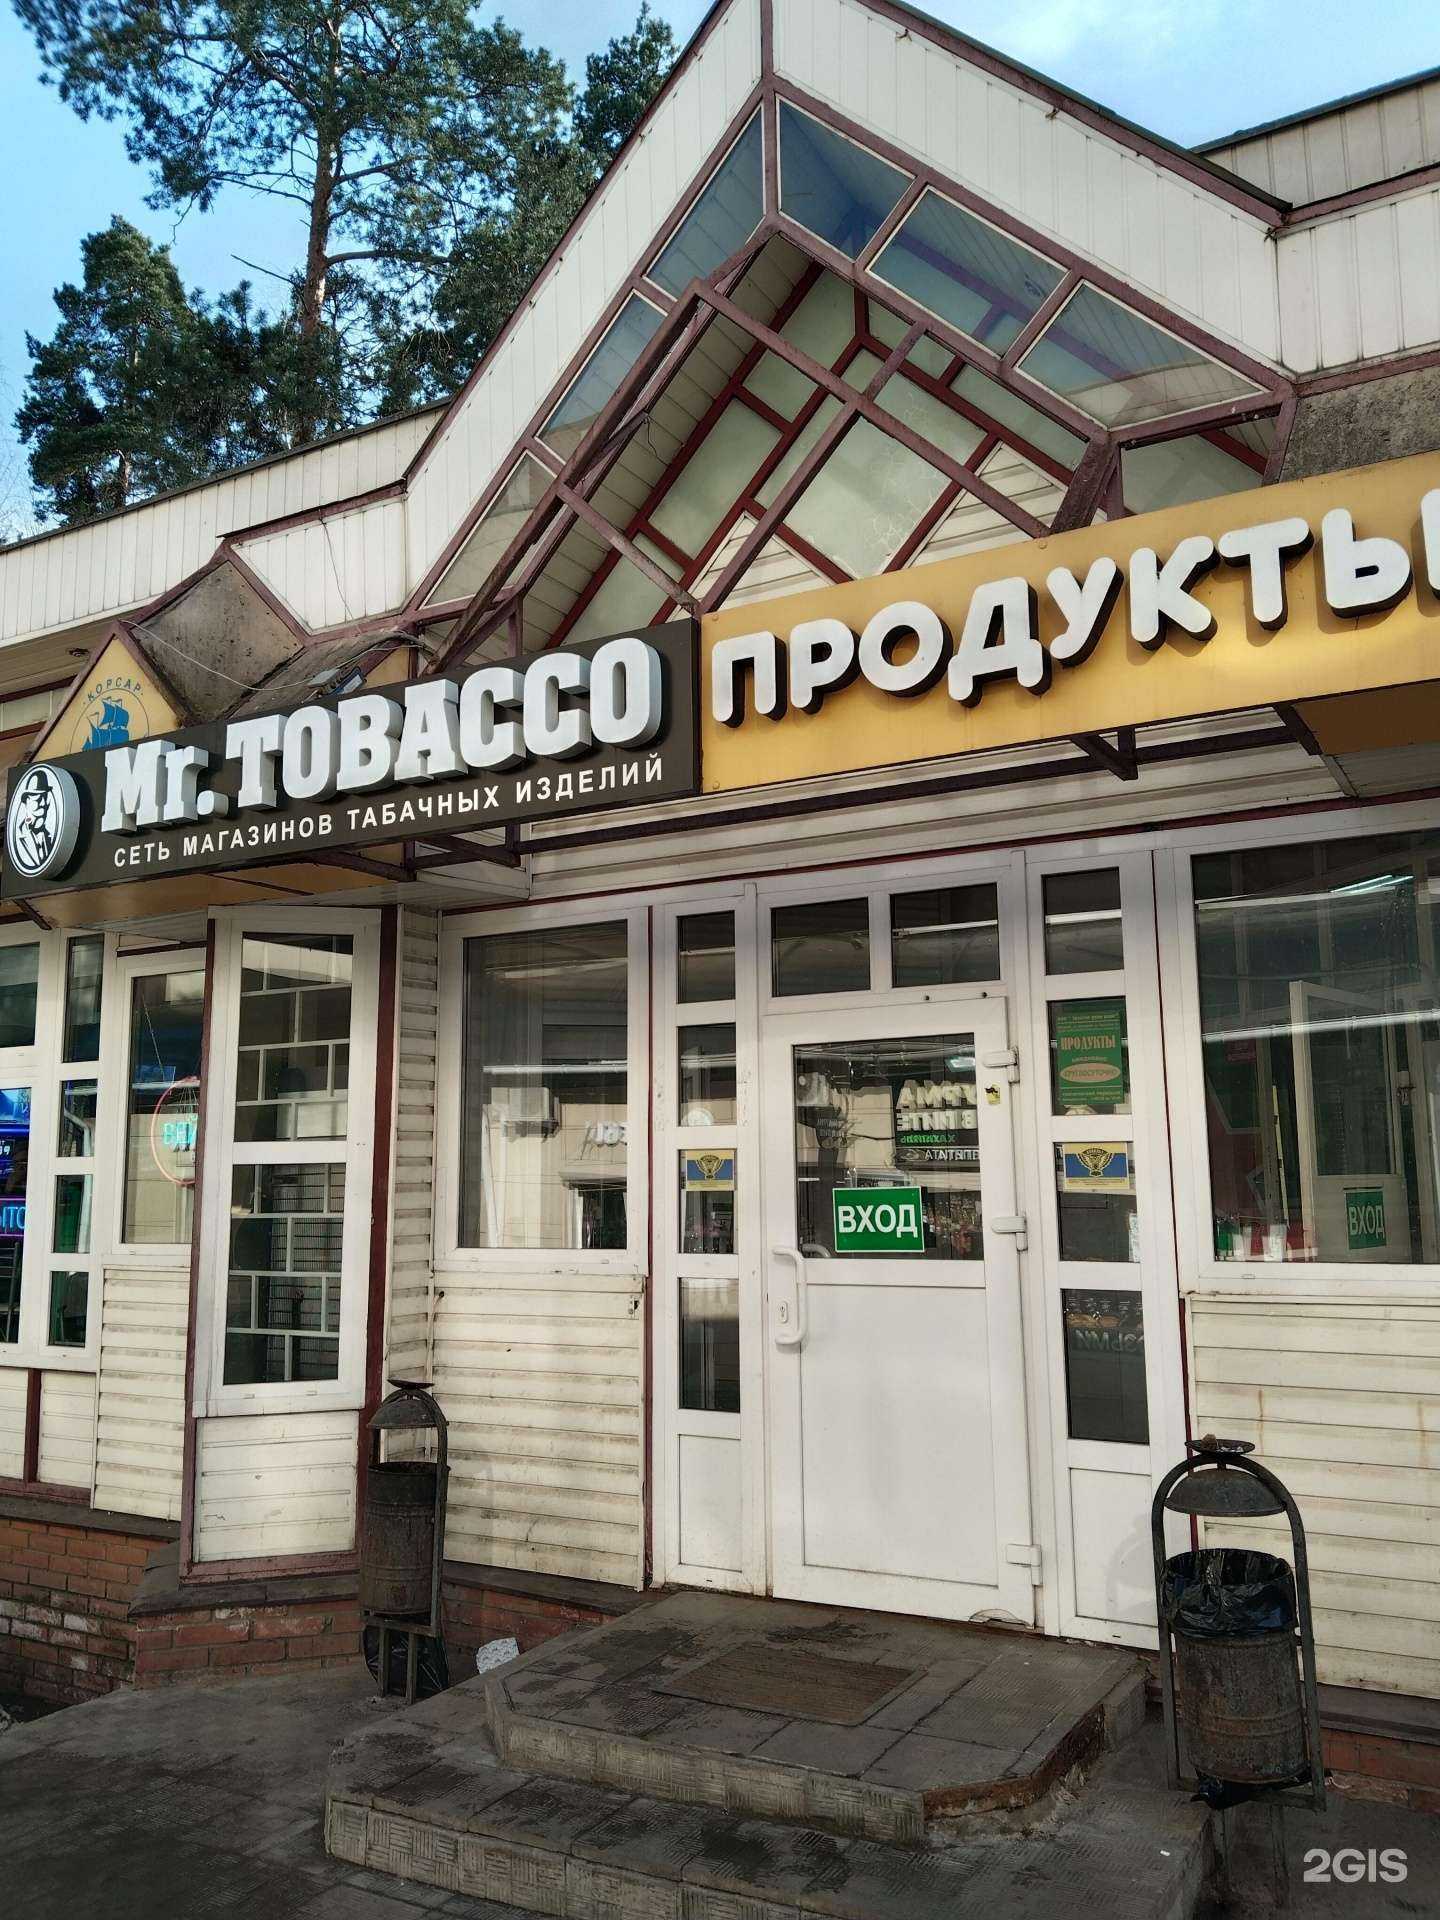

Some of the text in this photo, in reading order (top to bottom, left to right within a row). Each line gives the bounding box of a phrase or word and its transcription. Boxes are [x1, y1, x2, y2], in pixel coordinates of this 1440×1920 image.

[710, 487, 1440, 727] ПРОДУКТЫ
[87, 677, 141, 702] КОРСАР
[114, 752, 662, 868] СЕТЬ МАГАЗИНОВ ТАБАЧНЫХ ИЗДЕЛИЙ
[1060, 1034, 1116, 1051] ПРОДУКТЫ
[837, 1204, 919, 1238] ВХОД
[1349, 1206, 1386, 1239] ВХОД
